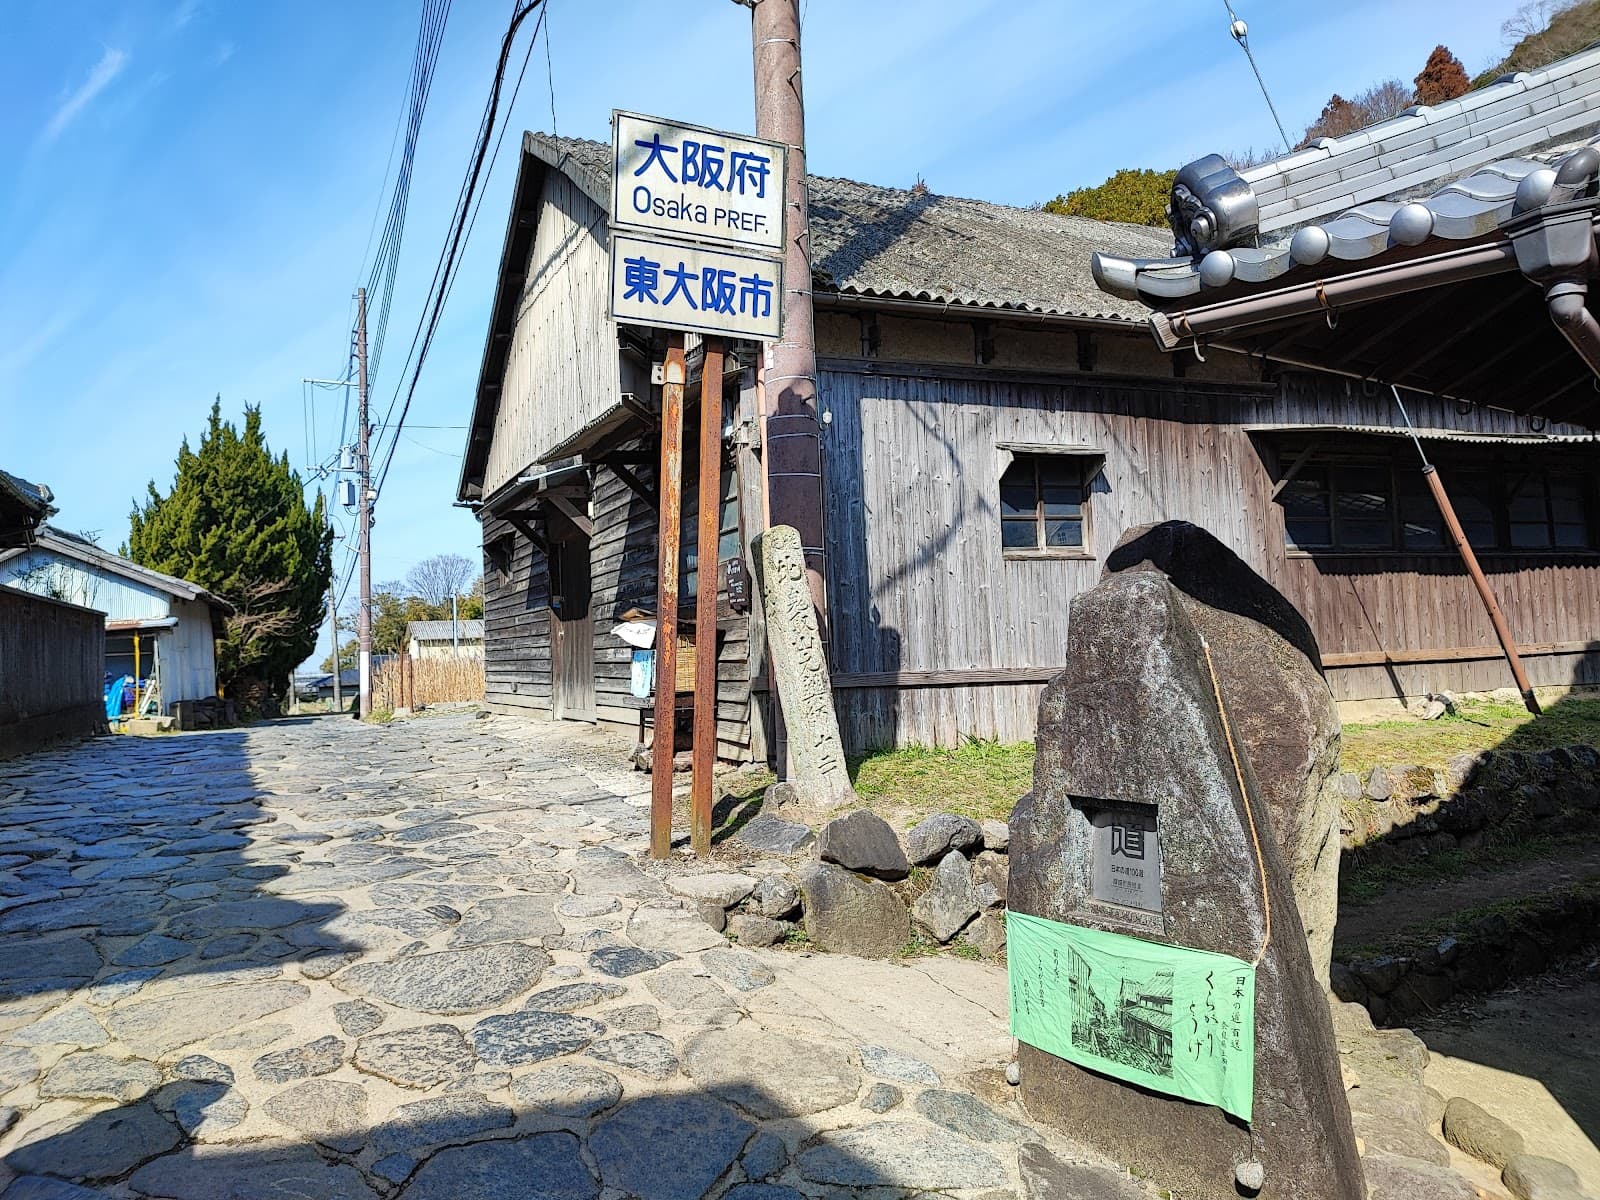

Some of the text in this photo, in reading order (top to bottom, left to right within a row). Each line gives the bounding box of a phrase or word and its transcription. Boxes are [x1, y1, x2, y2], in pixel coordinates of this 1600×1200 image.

[634, 133, 771, 199] 大阪府
[633, 186, 769, 234] Osaka PREF.
[623, 256, 774, 318] 東大阪市
[1111, 822, 1145, 860] 道
[1188, 1000, 1205, 1062] とうげ
[1204, 970, 1219, 1058] くらがり
